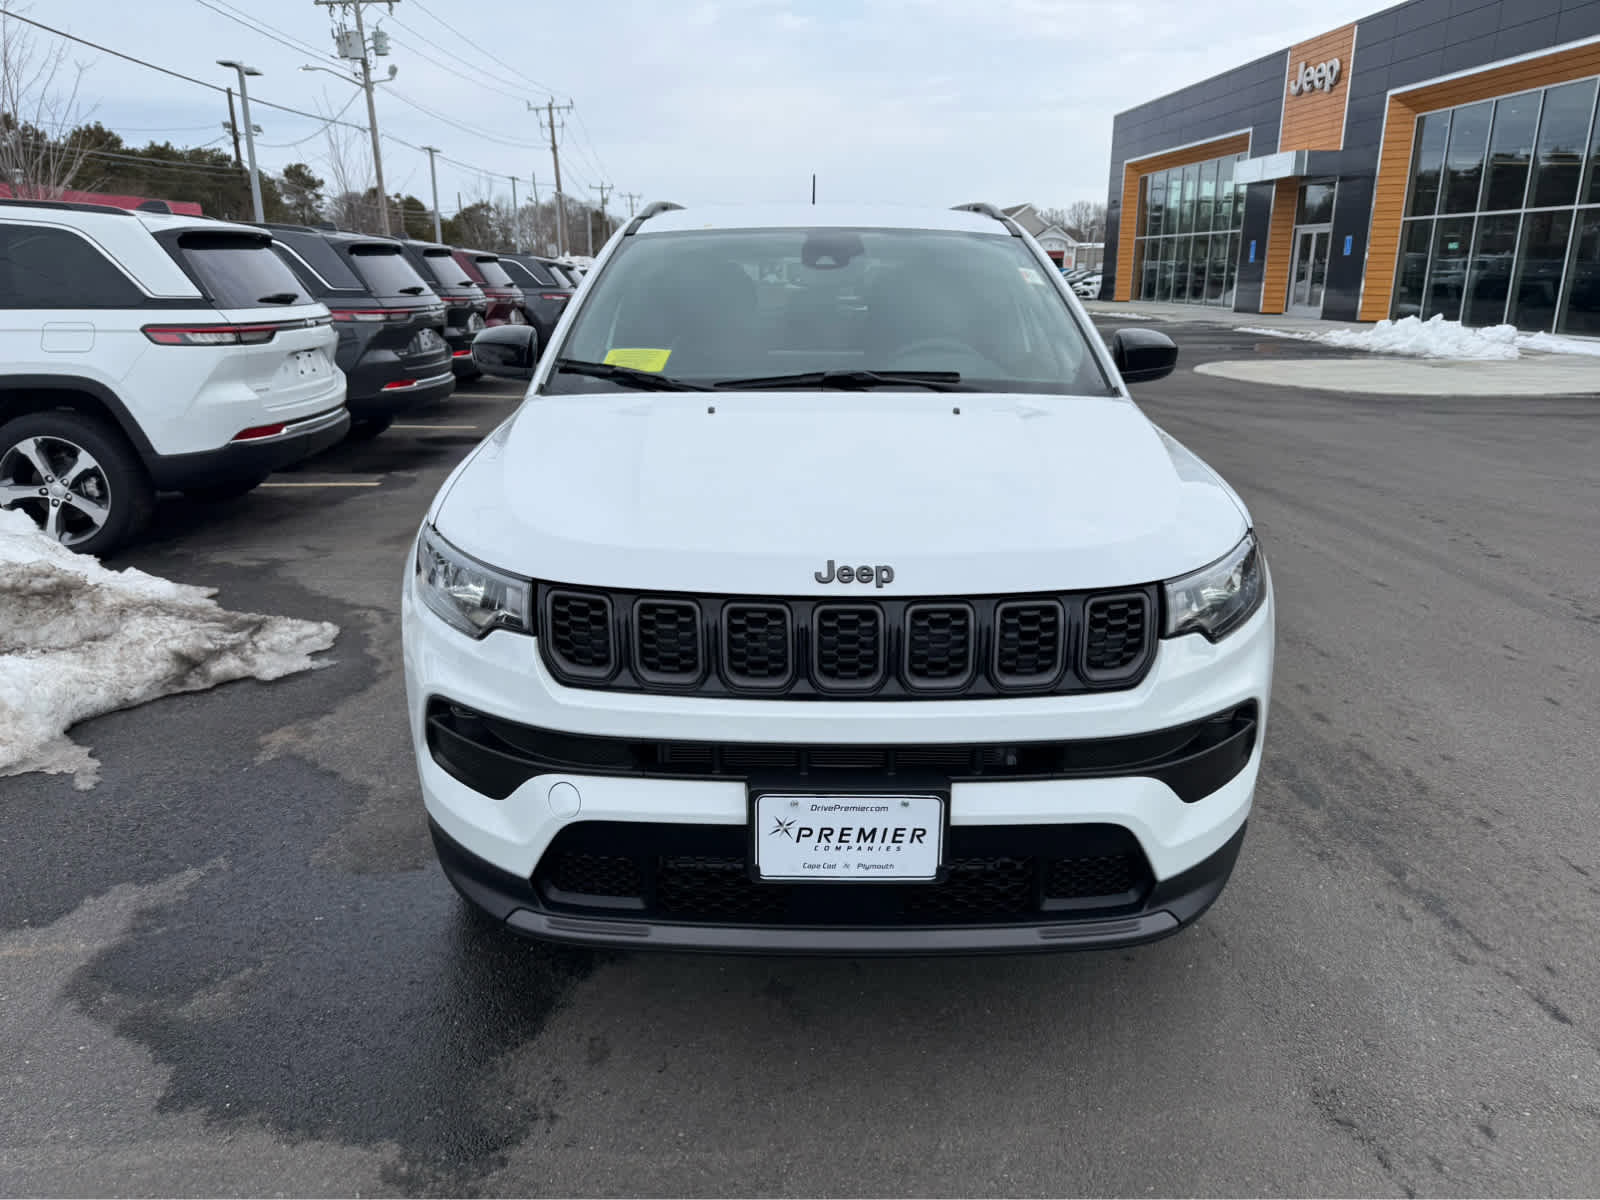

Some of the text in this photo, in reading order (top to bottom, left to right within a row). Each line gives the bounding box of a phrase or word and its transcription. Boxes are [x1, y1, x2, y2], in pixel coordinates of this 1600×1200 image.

[1290, 58, 1340, 96] Jeep
[814, 559, 895, 588] Jeep
[810, 804, 889, 812] DrivePremier.com
[796, 827, 927, 844] PREMIER
[802, 862, 837, 870] Cape Cod
[857, 862, 895, 871] Plymouth
